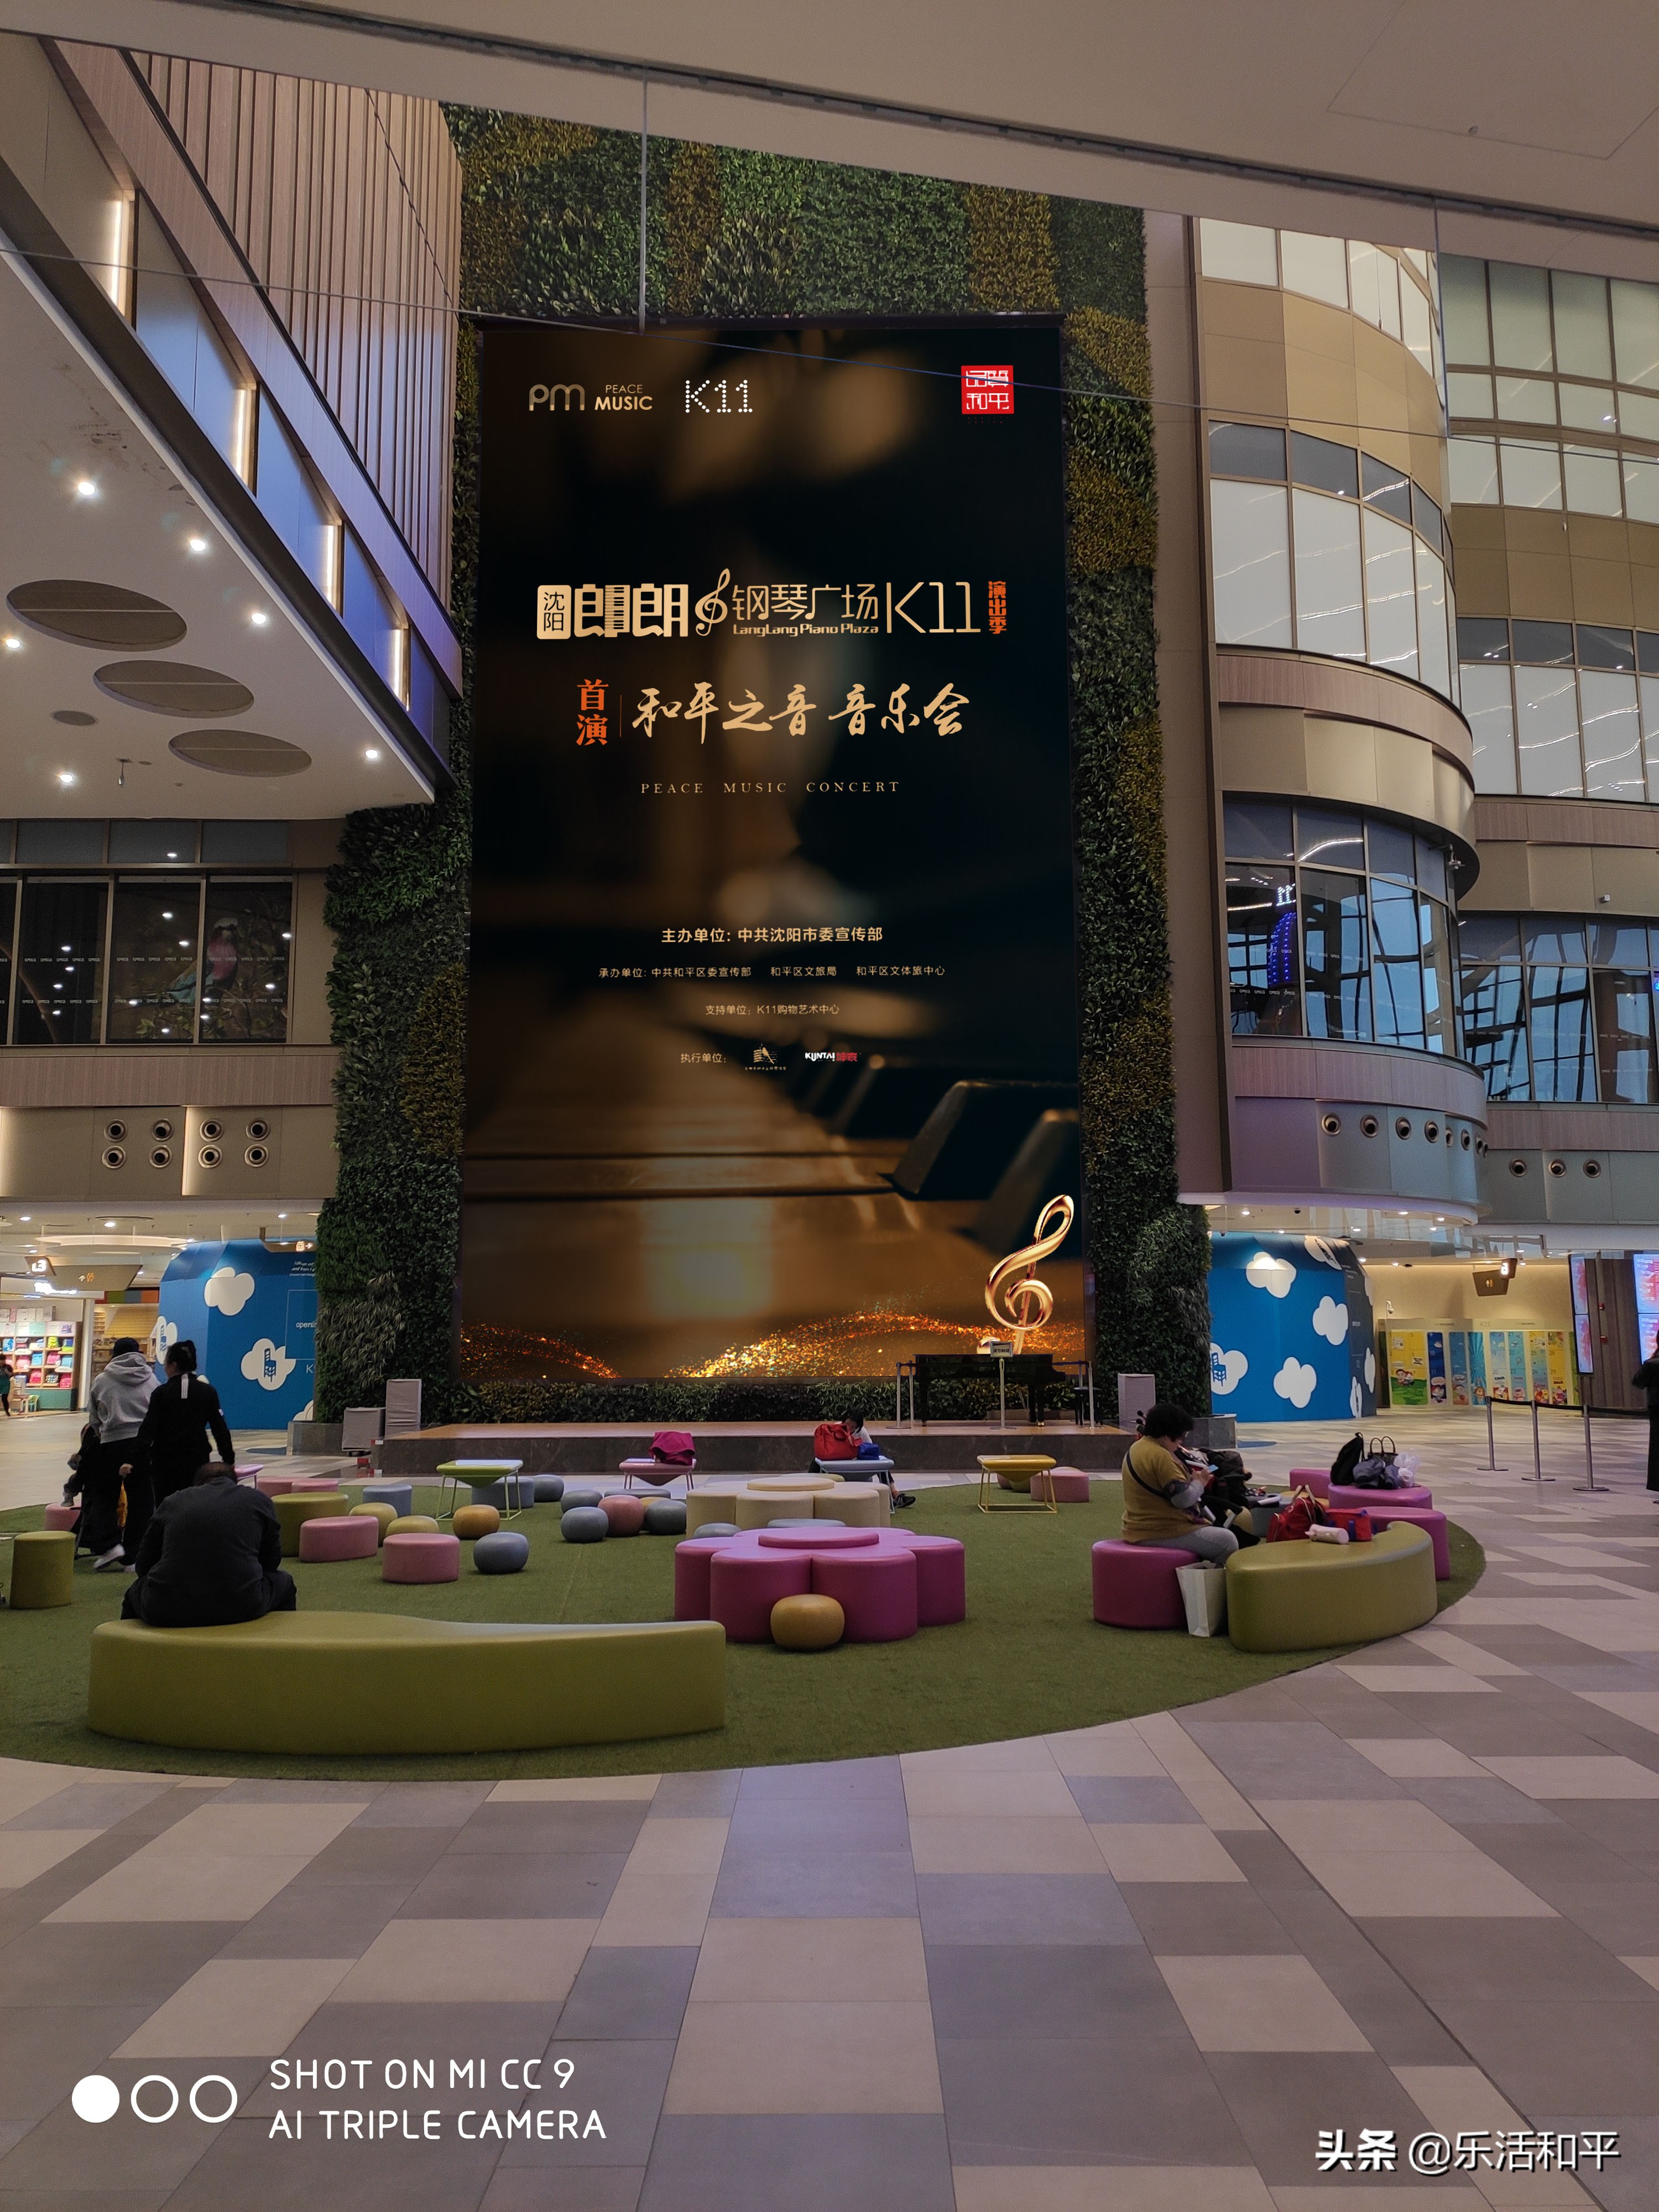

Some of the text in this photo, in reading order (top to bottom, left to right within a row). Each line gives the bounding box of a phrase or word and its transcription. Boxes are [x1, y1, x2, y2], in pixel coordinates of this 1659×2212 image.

[606, 384, 643, 394] PEACE
[685, 379, 753, 413] K11
[594, 396, 653, 410] MUSIC
[543, 591, 565, 632] 沈阳
[732, 584, 878, 620] 钢琴广场
[886, 582, 981, 634] K11
[988, 581, 1007, 634] 演出季
[800, 623, 839, 634] Piano
[841, 623, 879, 634] Plaza
[576, 679, 608, 745] 首演
[632, 682, 969, 744] 和平之音 音乐会
[641, 781, 900, 794] PEACE MUSIC CONCERT
[770, 966, 837, 977] 和平区文旅局
